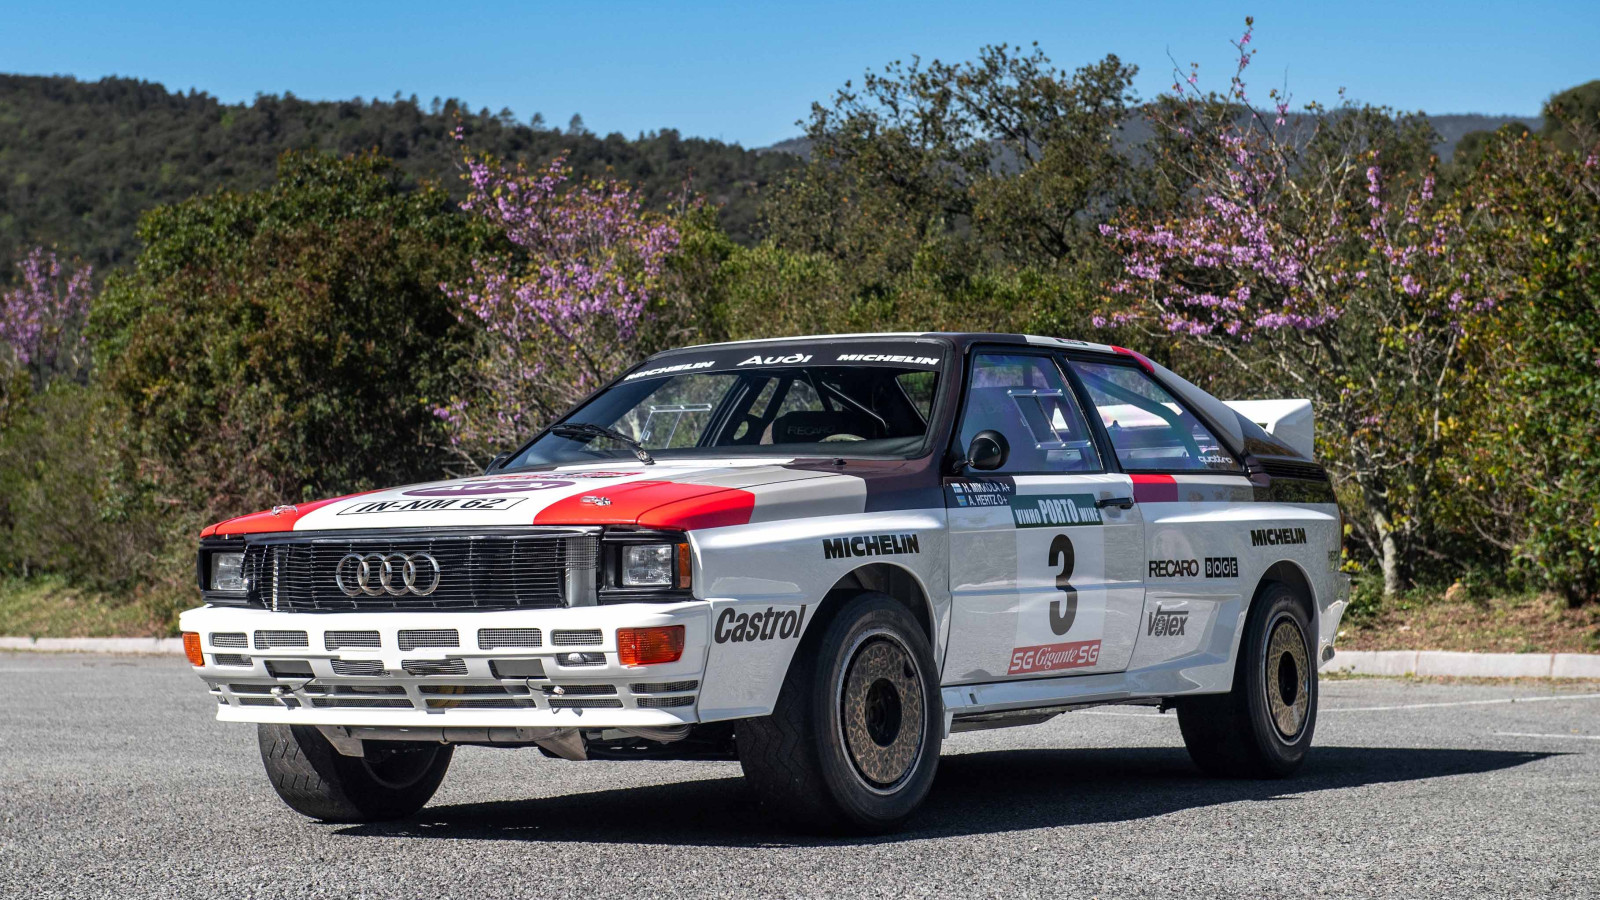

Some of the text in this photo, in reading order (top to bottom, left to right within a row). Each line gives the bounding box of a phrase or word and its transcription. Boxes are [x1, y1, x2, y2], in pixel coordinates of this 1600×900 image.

[836, 354, 940, 365] MICHELIN
[624, 361, 715, 381] MICHELIN
[1198, 455, 1233, 465] quattro
[961, 482, 1010, 493] H. MIKKOLA A+
[356, 498, 507, 512] IN-NM 62
[968, 495, 977, 506] A.
[975, 494, 998, 505] HERTZ
[1015, 499, 1100, 524] VINHO PORTO WINE
[1251, 528, 1307, 546] MICHELIN
[823, 534, 920, 559] MICHELIN
[1149, 559, 1199, 578] RECARO
[1206, 559, 1239, 577] BOGE
[1048, 534, 1078, 635] 3
[715, 605, 806, 644] Castrol
[1011, 644, 1100, 671] SG Gigante SG
